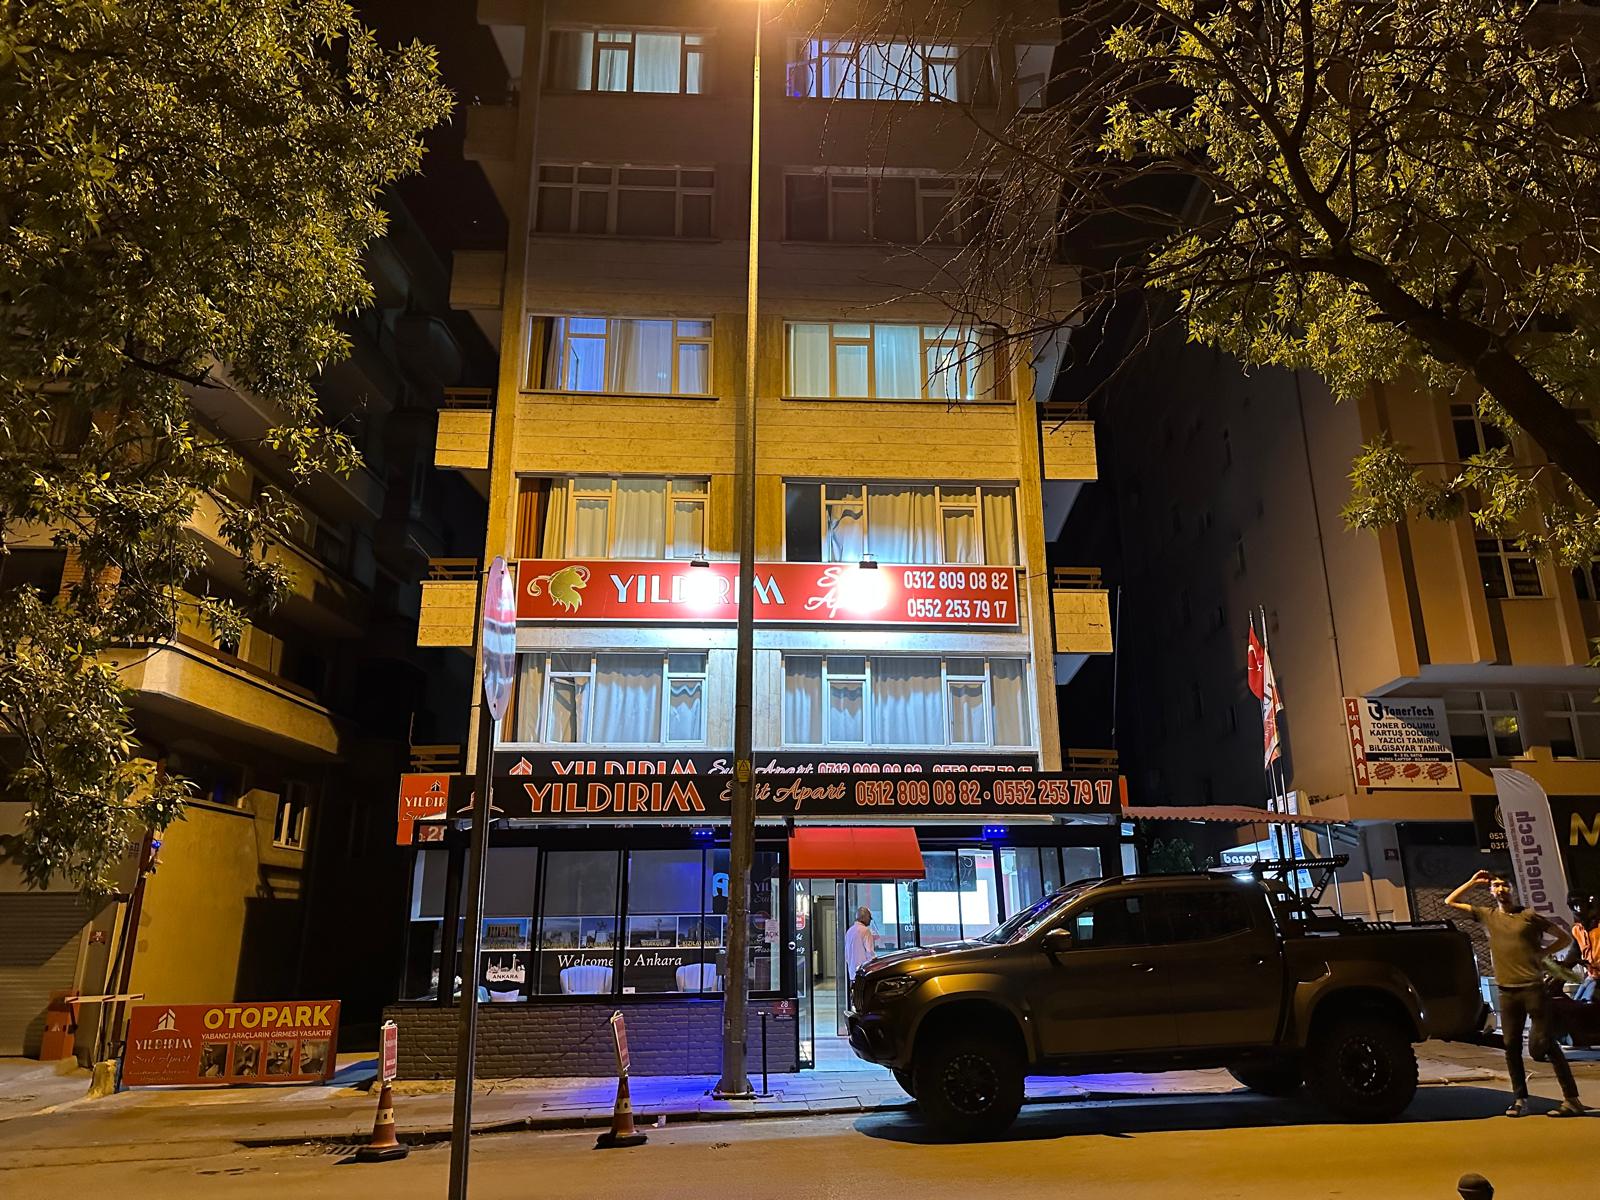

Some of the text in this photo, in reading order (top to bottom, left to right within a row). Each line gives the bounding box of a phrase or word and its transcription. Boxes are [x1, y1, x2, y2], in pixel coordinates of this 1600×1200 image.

[903, 570, 1009, 590] 0312 809 08 82
[907, 598, 1007, 618] 0552 253 79 17
[1348, 701, 1355, 713] 1
[1383, 706, 1434, 716] TonerTech
[523, 778, 1113, 813] YILDIRIM Sit Apart 0312 809 08 82 0552 253 79 17
[557, 954, 614, 968] Welcome
[634, 952, 682, 967] Ankara
[203, 1004, 332, 1030] OTOPARK
[201, 1032, 231, 1040] YABANCI
[231, 1031, 270, 1040] ARAÇLARIN
[299, 1029, 332, 1037] YASAKTIR
[135, 1037, 193, 1051] YILDIRIM
